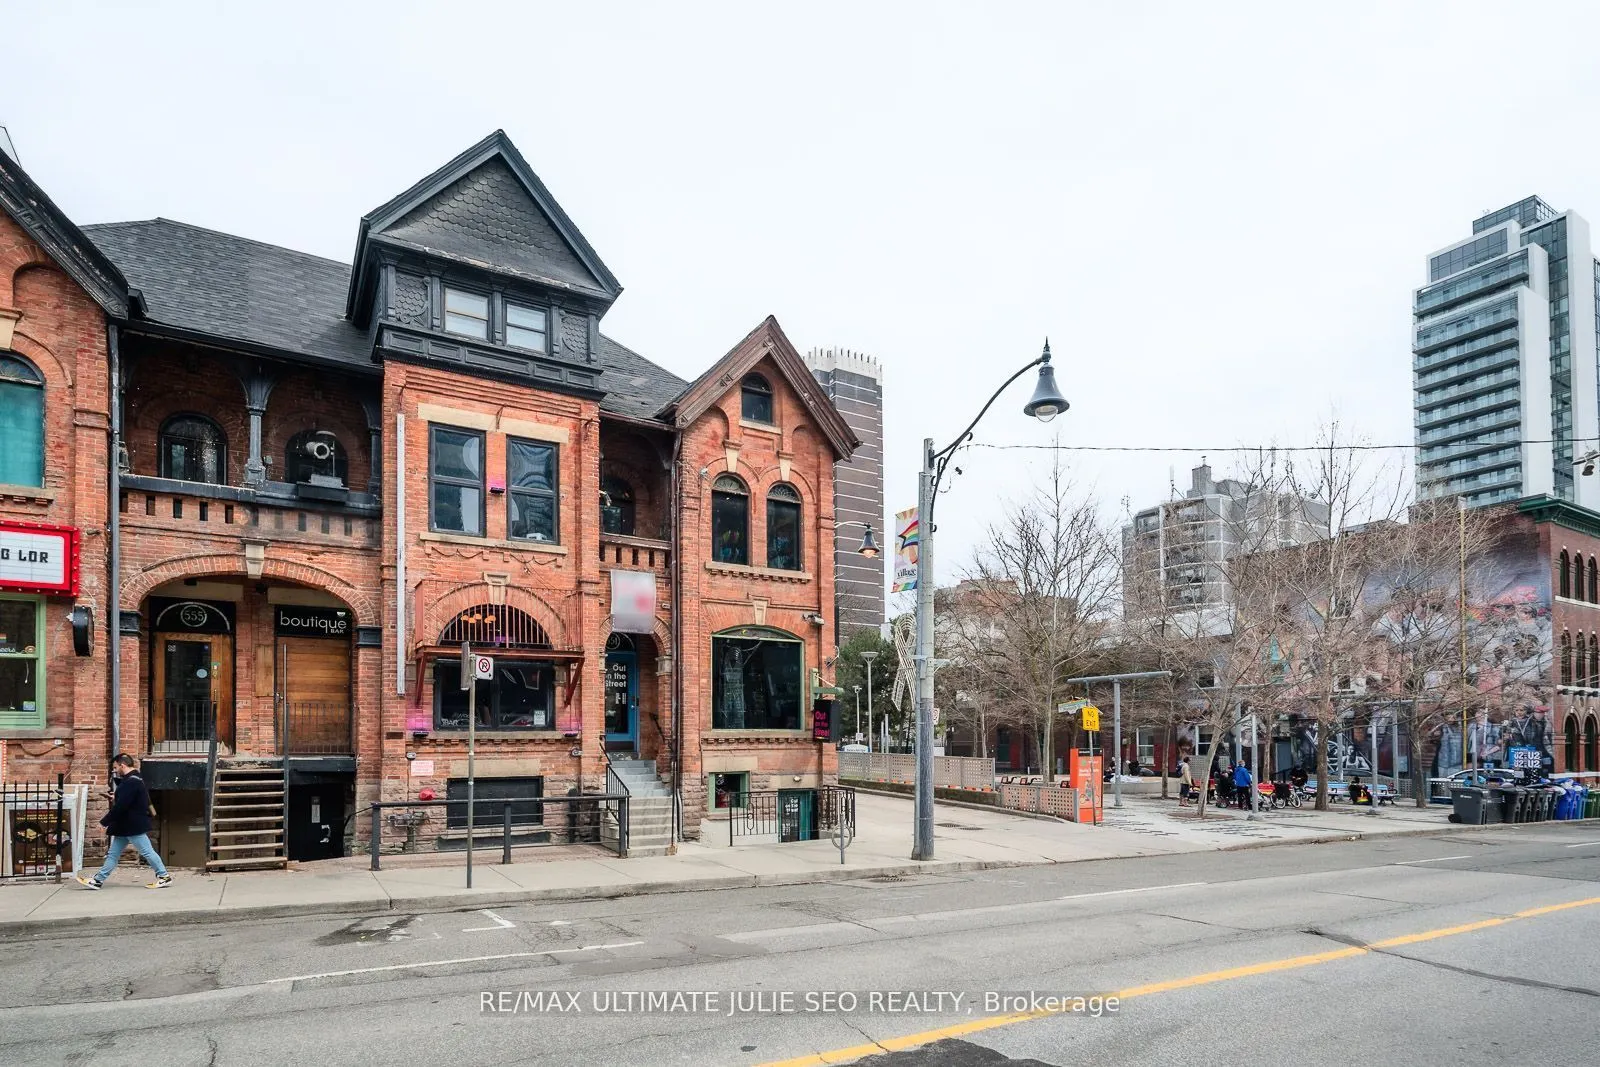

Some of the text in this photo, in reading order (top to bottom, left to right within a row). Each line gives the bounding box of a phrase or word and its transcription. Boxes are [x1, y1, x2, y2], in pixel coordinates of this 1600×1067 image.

[19, 550, 48, 563] LOR
[184, 611, 204, 621] 555
[280, 610, 347, 634] boutique
